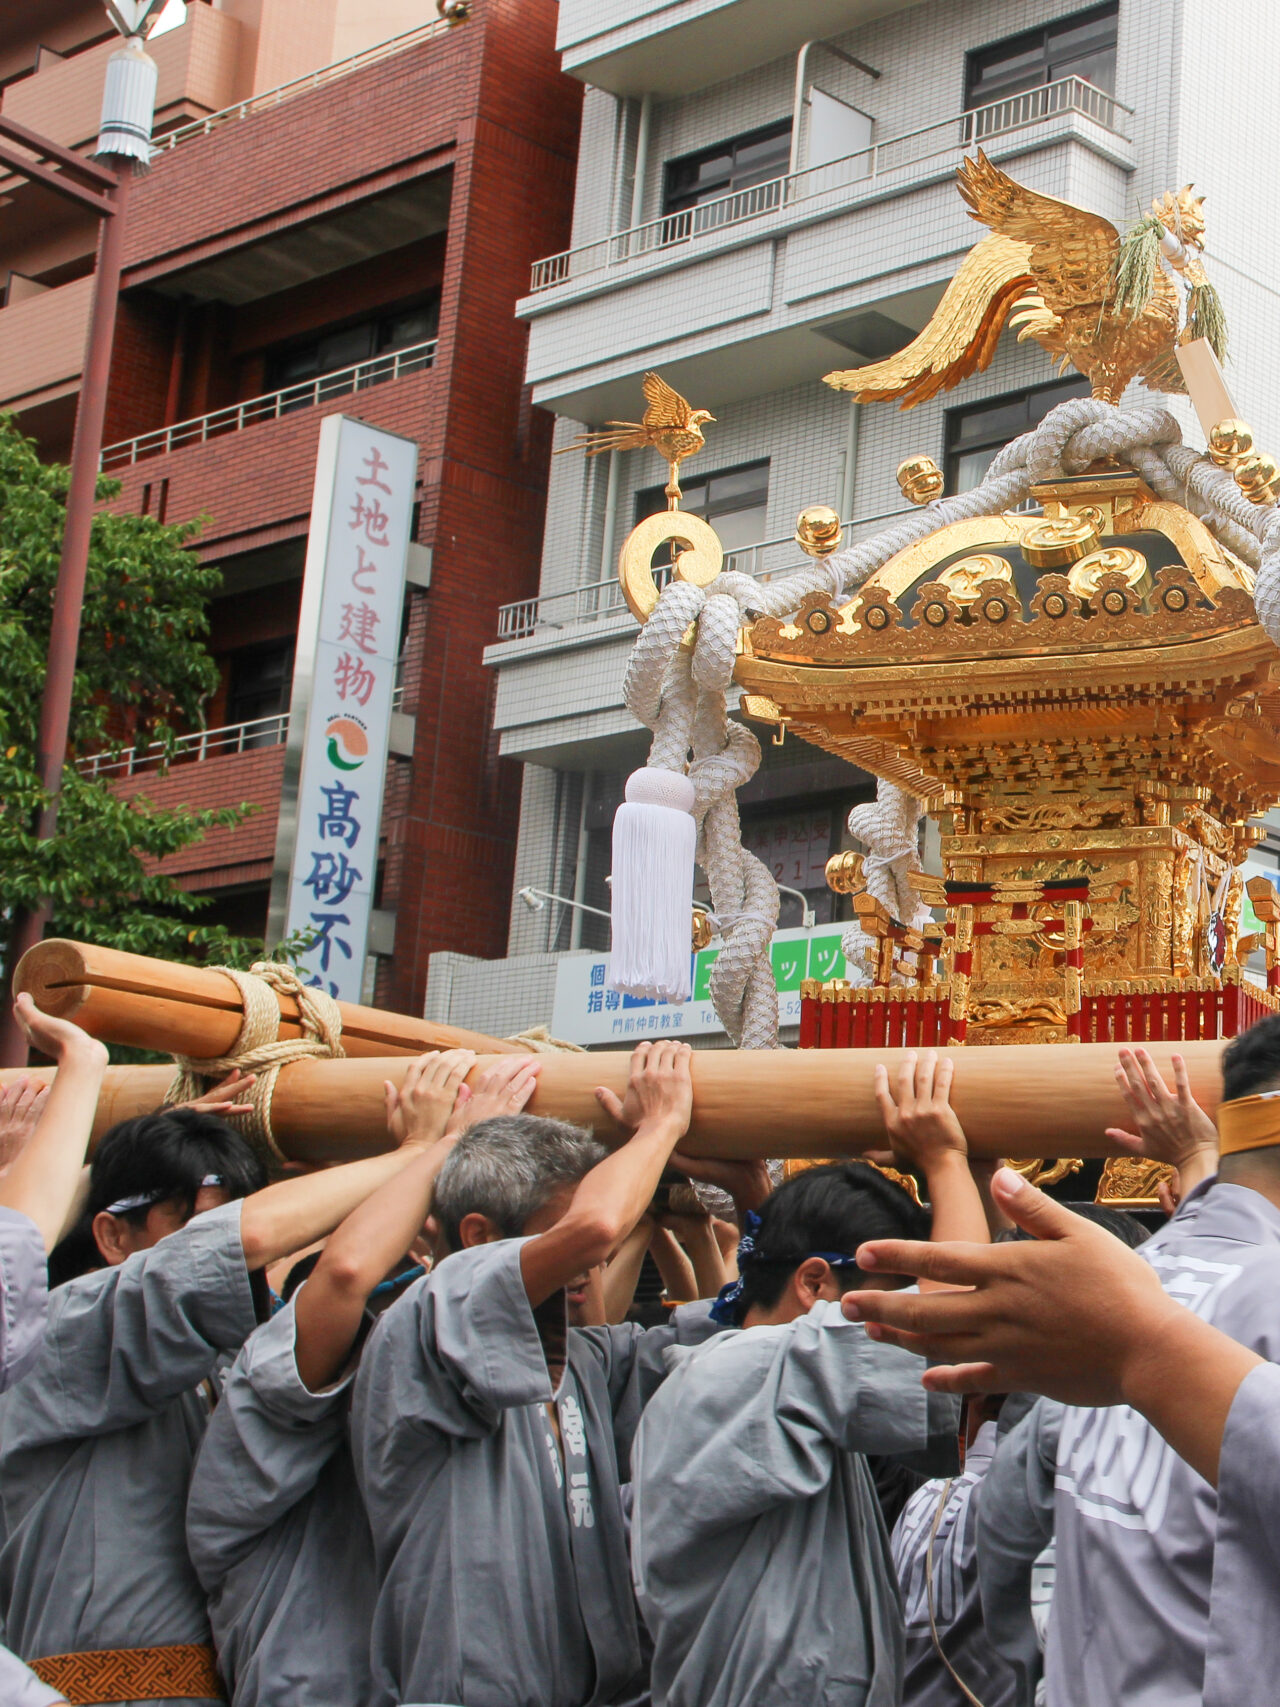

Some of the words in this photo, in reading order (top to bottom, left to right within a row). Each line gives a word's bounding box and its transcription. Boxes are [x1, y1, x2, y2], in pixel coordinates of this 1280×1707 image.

[332, 446, 393, 707] 土地と建物
[587, 989, 621, 1014] 指導
[612, 1012, 684, 1035] 門前仲町教室
